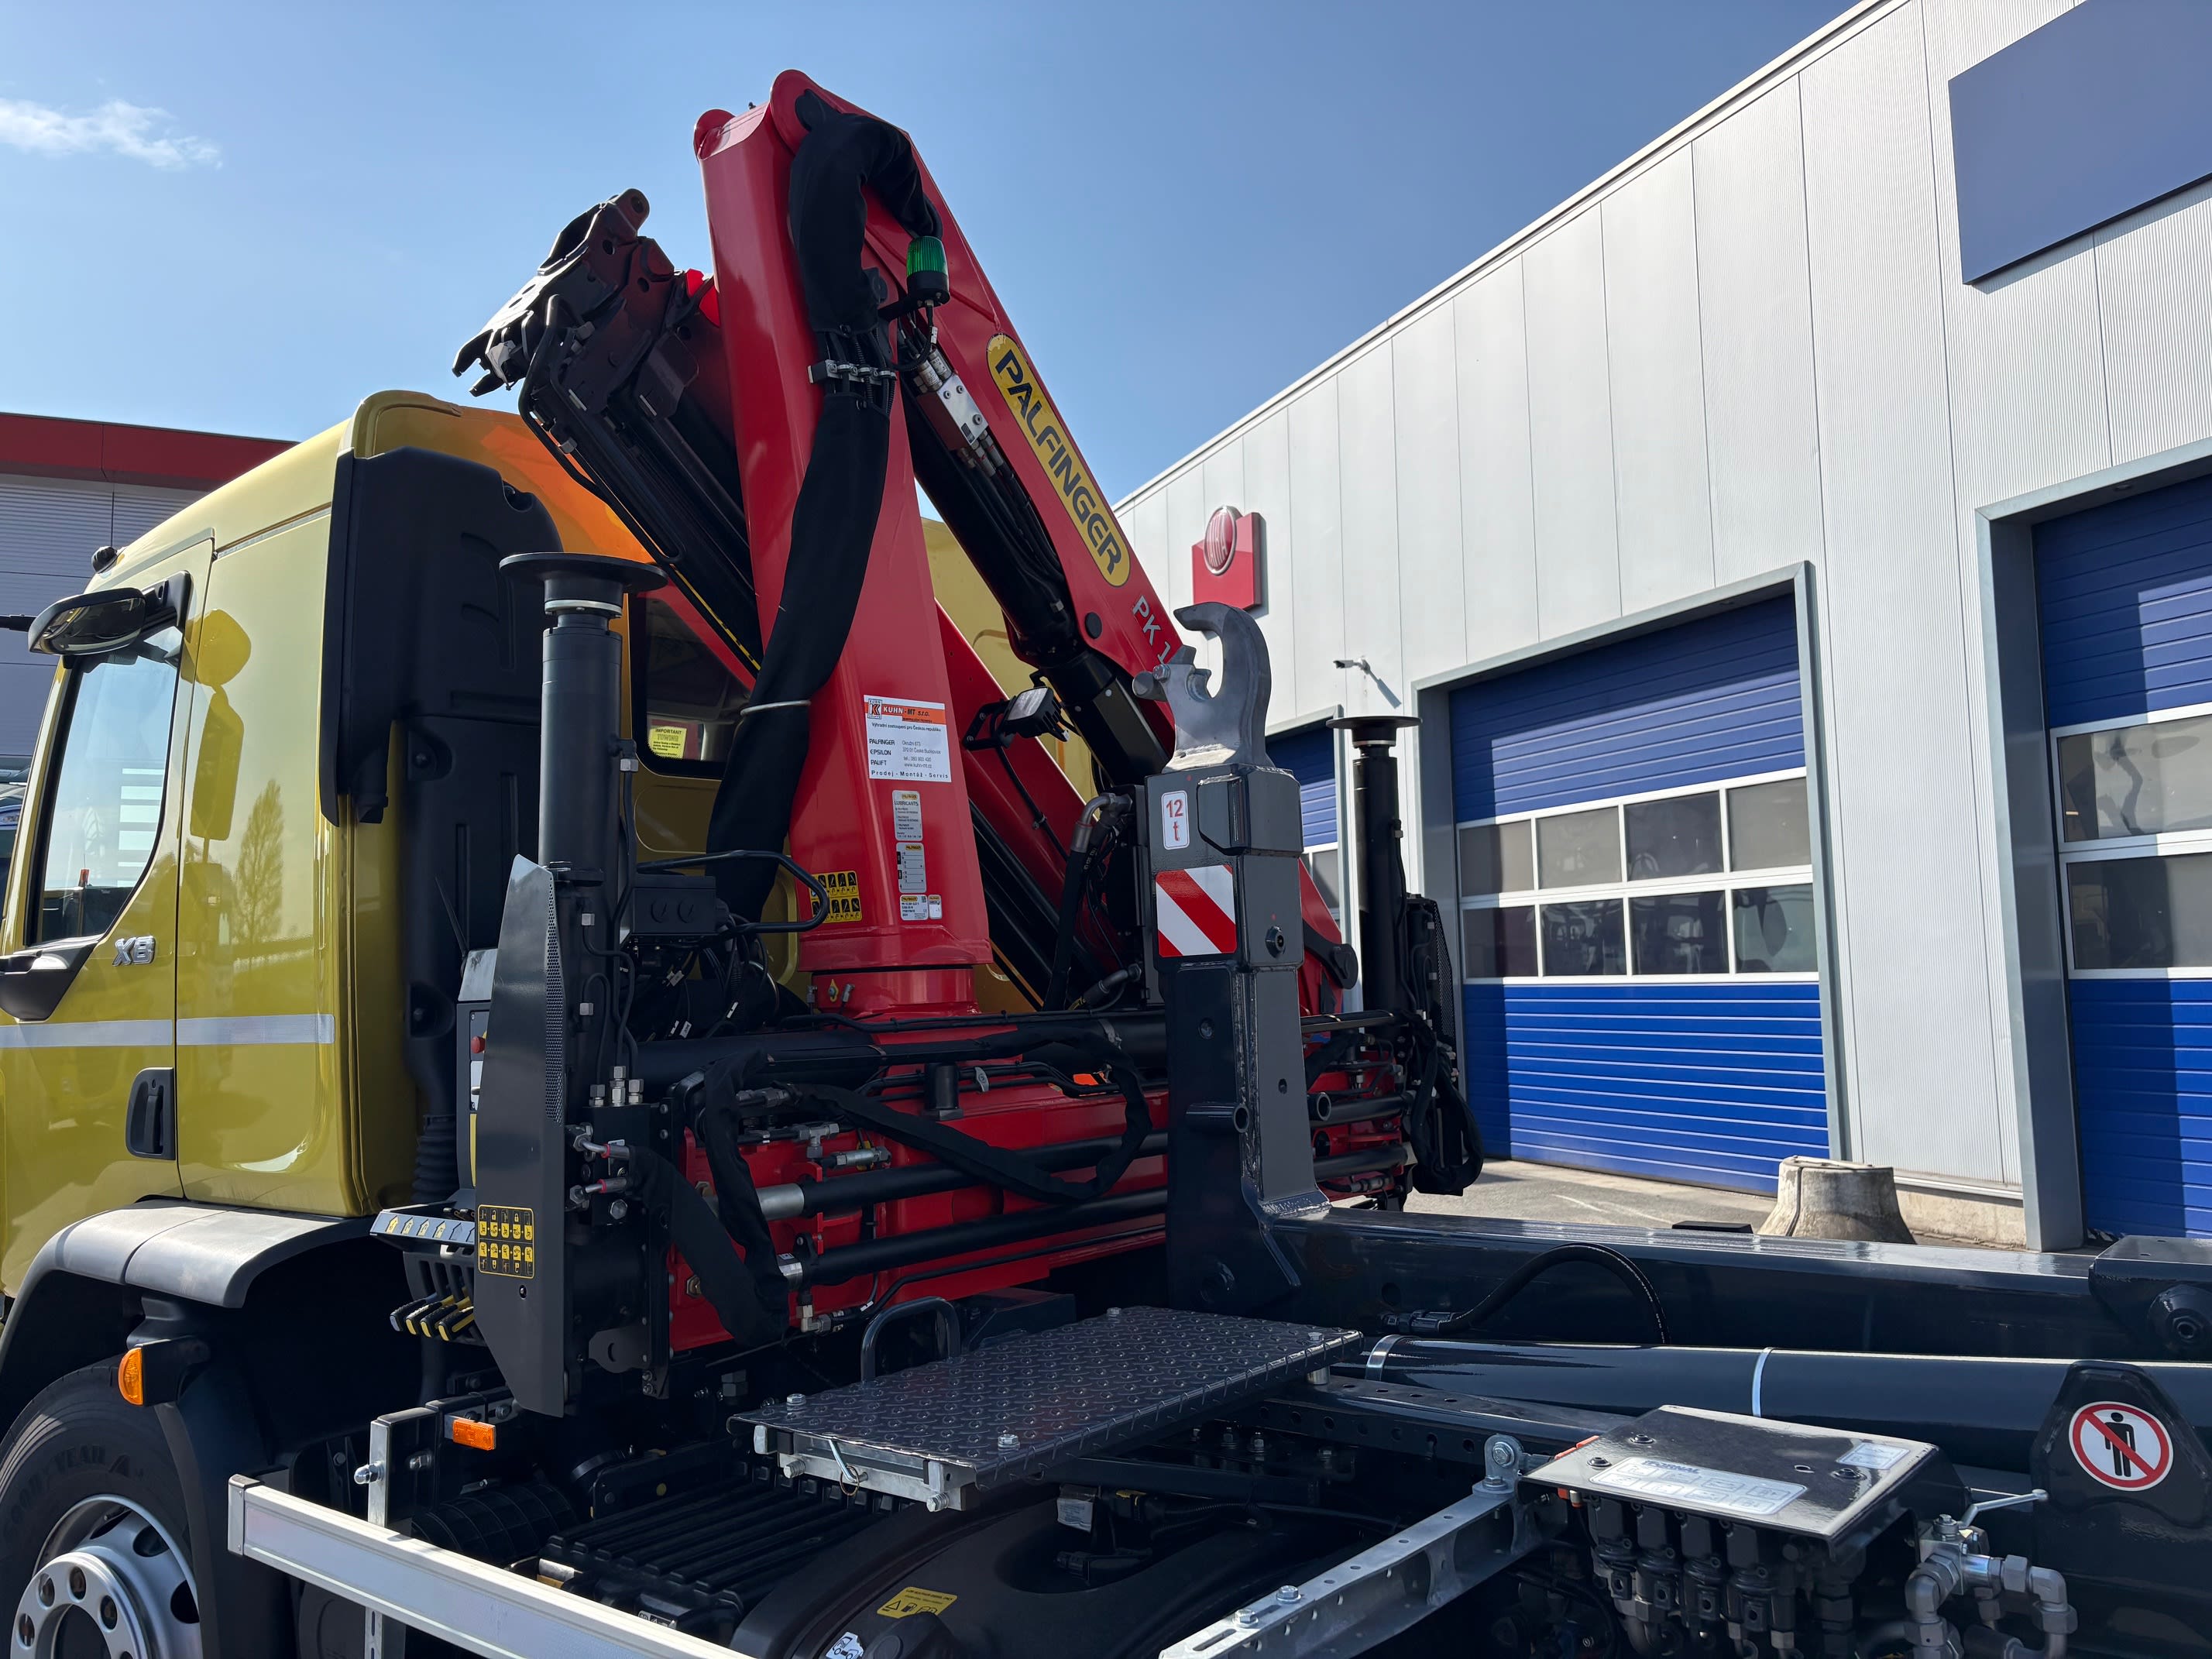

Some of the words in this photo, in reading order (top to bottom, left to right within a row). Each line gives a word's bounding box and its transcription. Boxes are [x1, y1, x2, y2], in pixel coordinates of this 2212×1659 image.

[995, 349, 1121, 575] PALFINGER
[1132, 595, 1161, 646] PK
[883, 706, 903, 714] KUHN
[1166, 799, 1184, 818] 12
[1173, 821, 1180, 841] t
